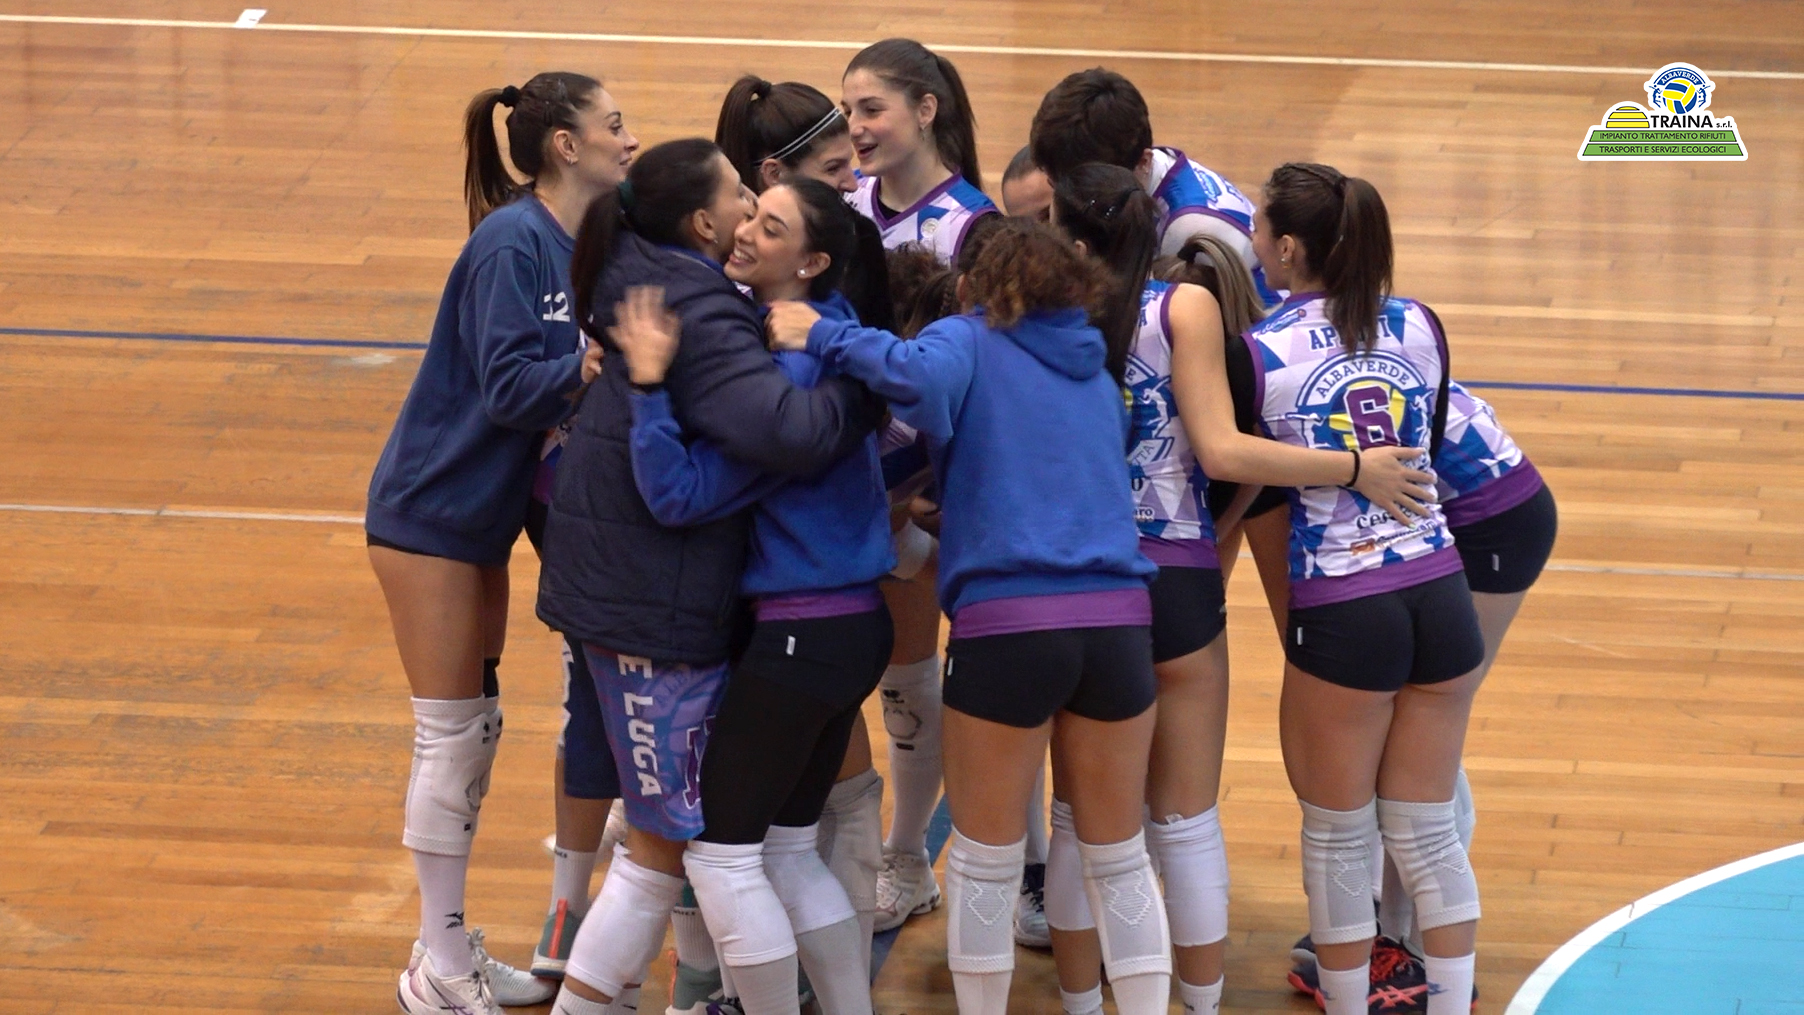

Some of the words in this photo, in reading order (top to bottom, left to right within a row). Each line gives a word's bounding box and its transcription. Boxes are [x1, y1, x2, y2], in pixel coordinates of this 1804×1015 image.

[543, 291, 570, 322] 12
[1315, 361, 1411, 398] ALBAVERDE
[1344, 386, 1400, 450] 6
